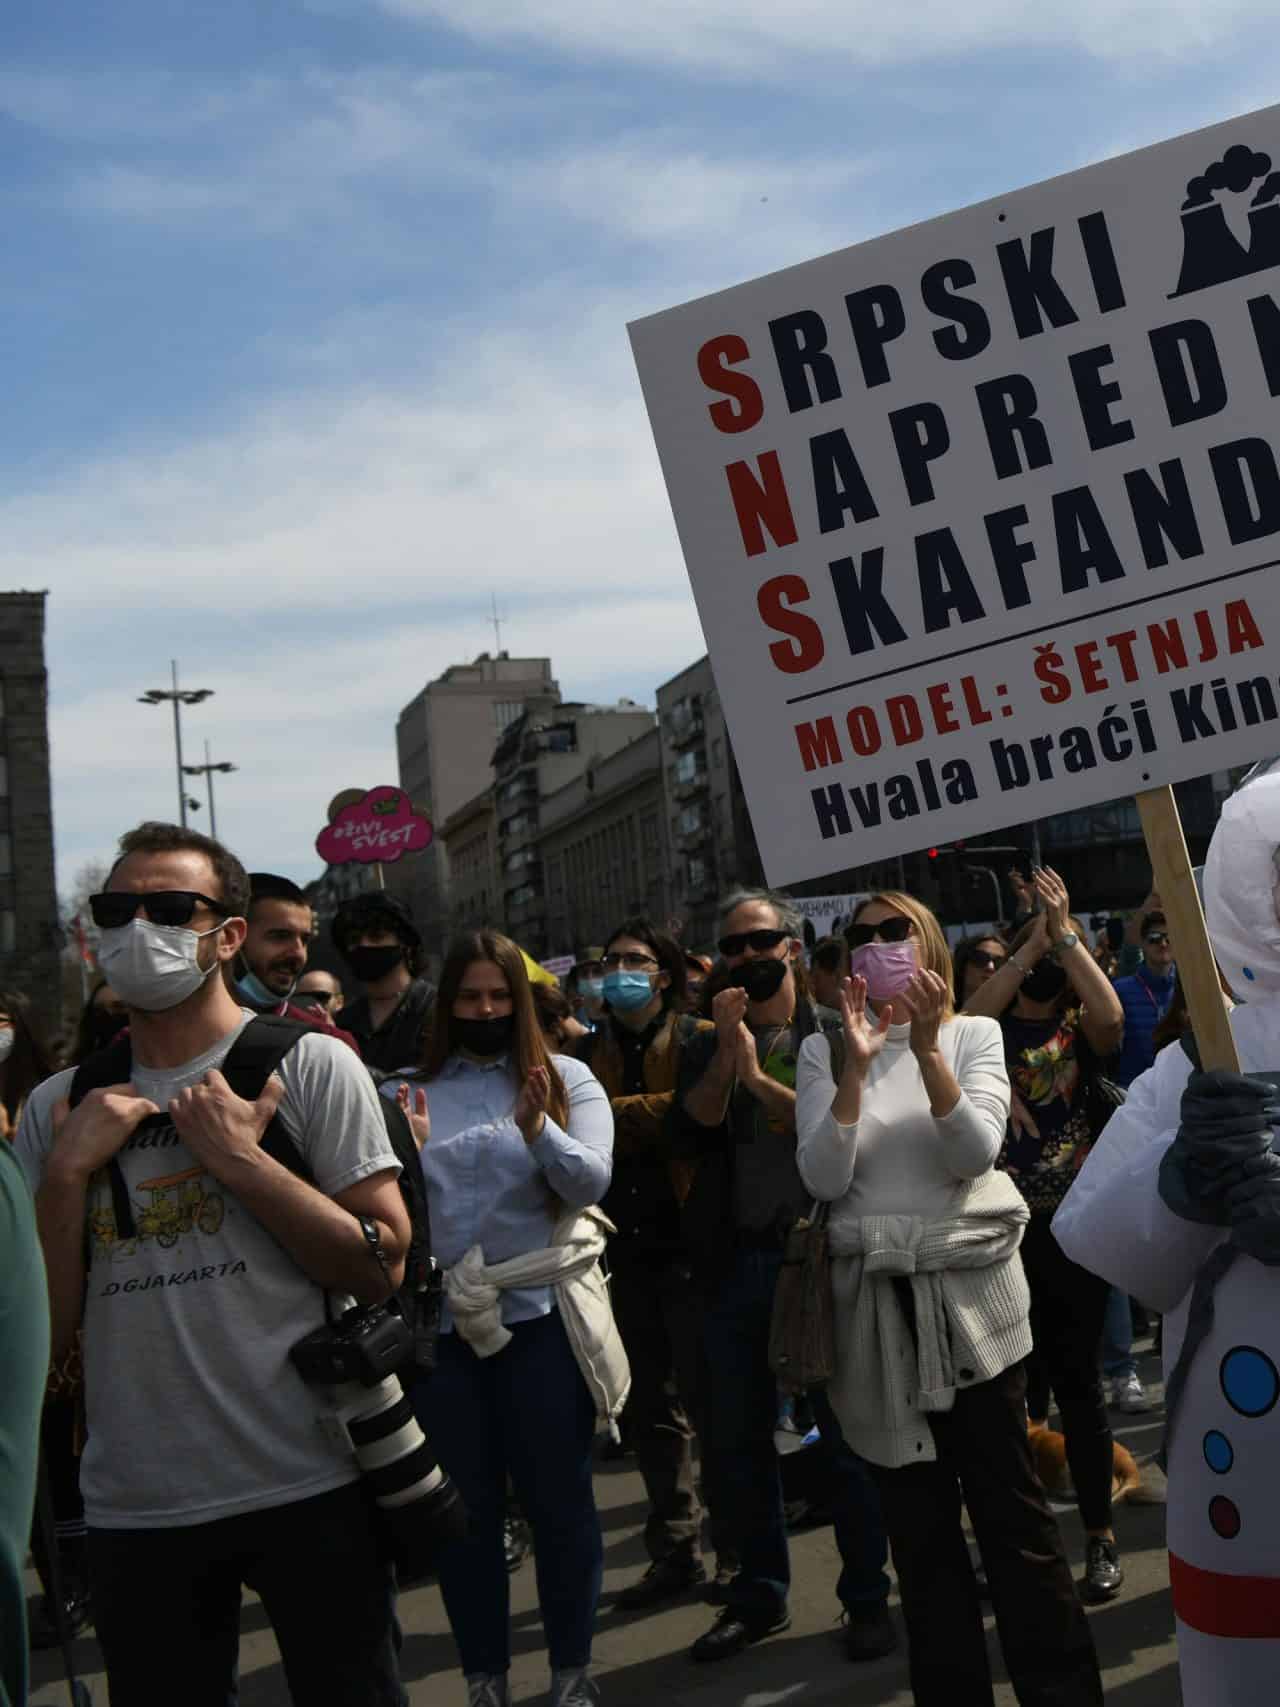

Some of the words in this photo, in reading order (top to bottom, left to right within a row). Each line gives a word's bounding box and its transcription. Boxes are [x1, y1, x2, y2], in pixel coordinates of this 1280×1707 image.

[696, 210, 1127, 434] SRPSKI
[794, 675, 1014, 773] MODEL:
[1032, 599, 1265, 705] ŠETNJA
[351, 823, 416, 850] SVEST
[810, 757, 979, 841] Hvala
[988, 698, 1158, 792] braći
[101, 1260, 248, 1297] OGJAKARTA
